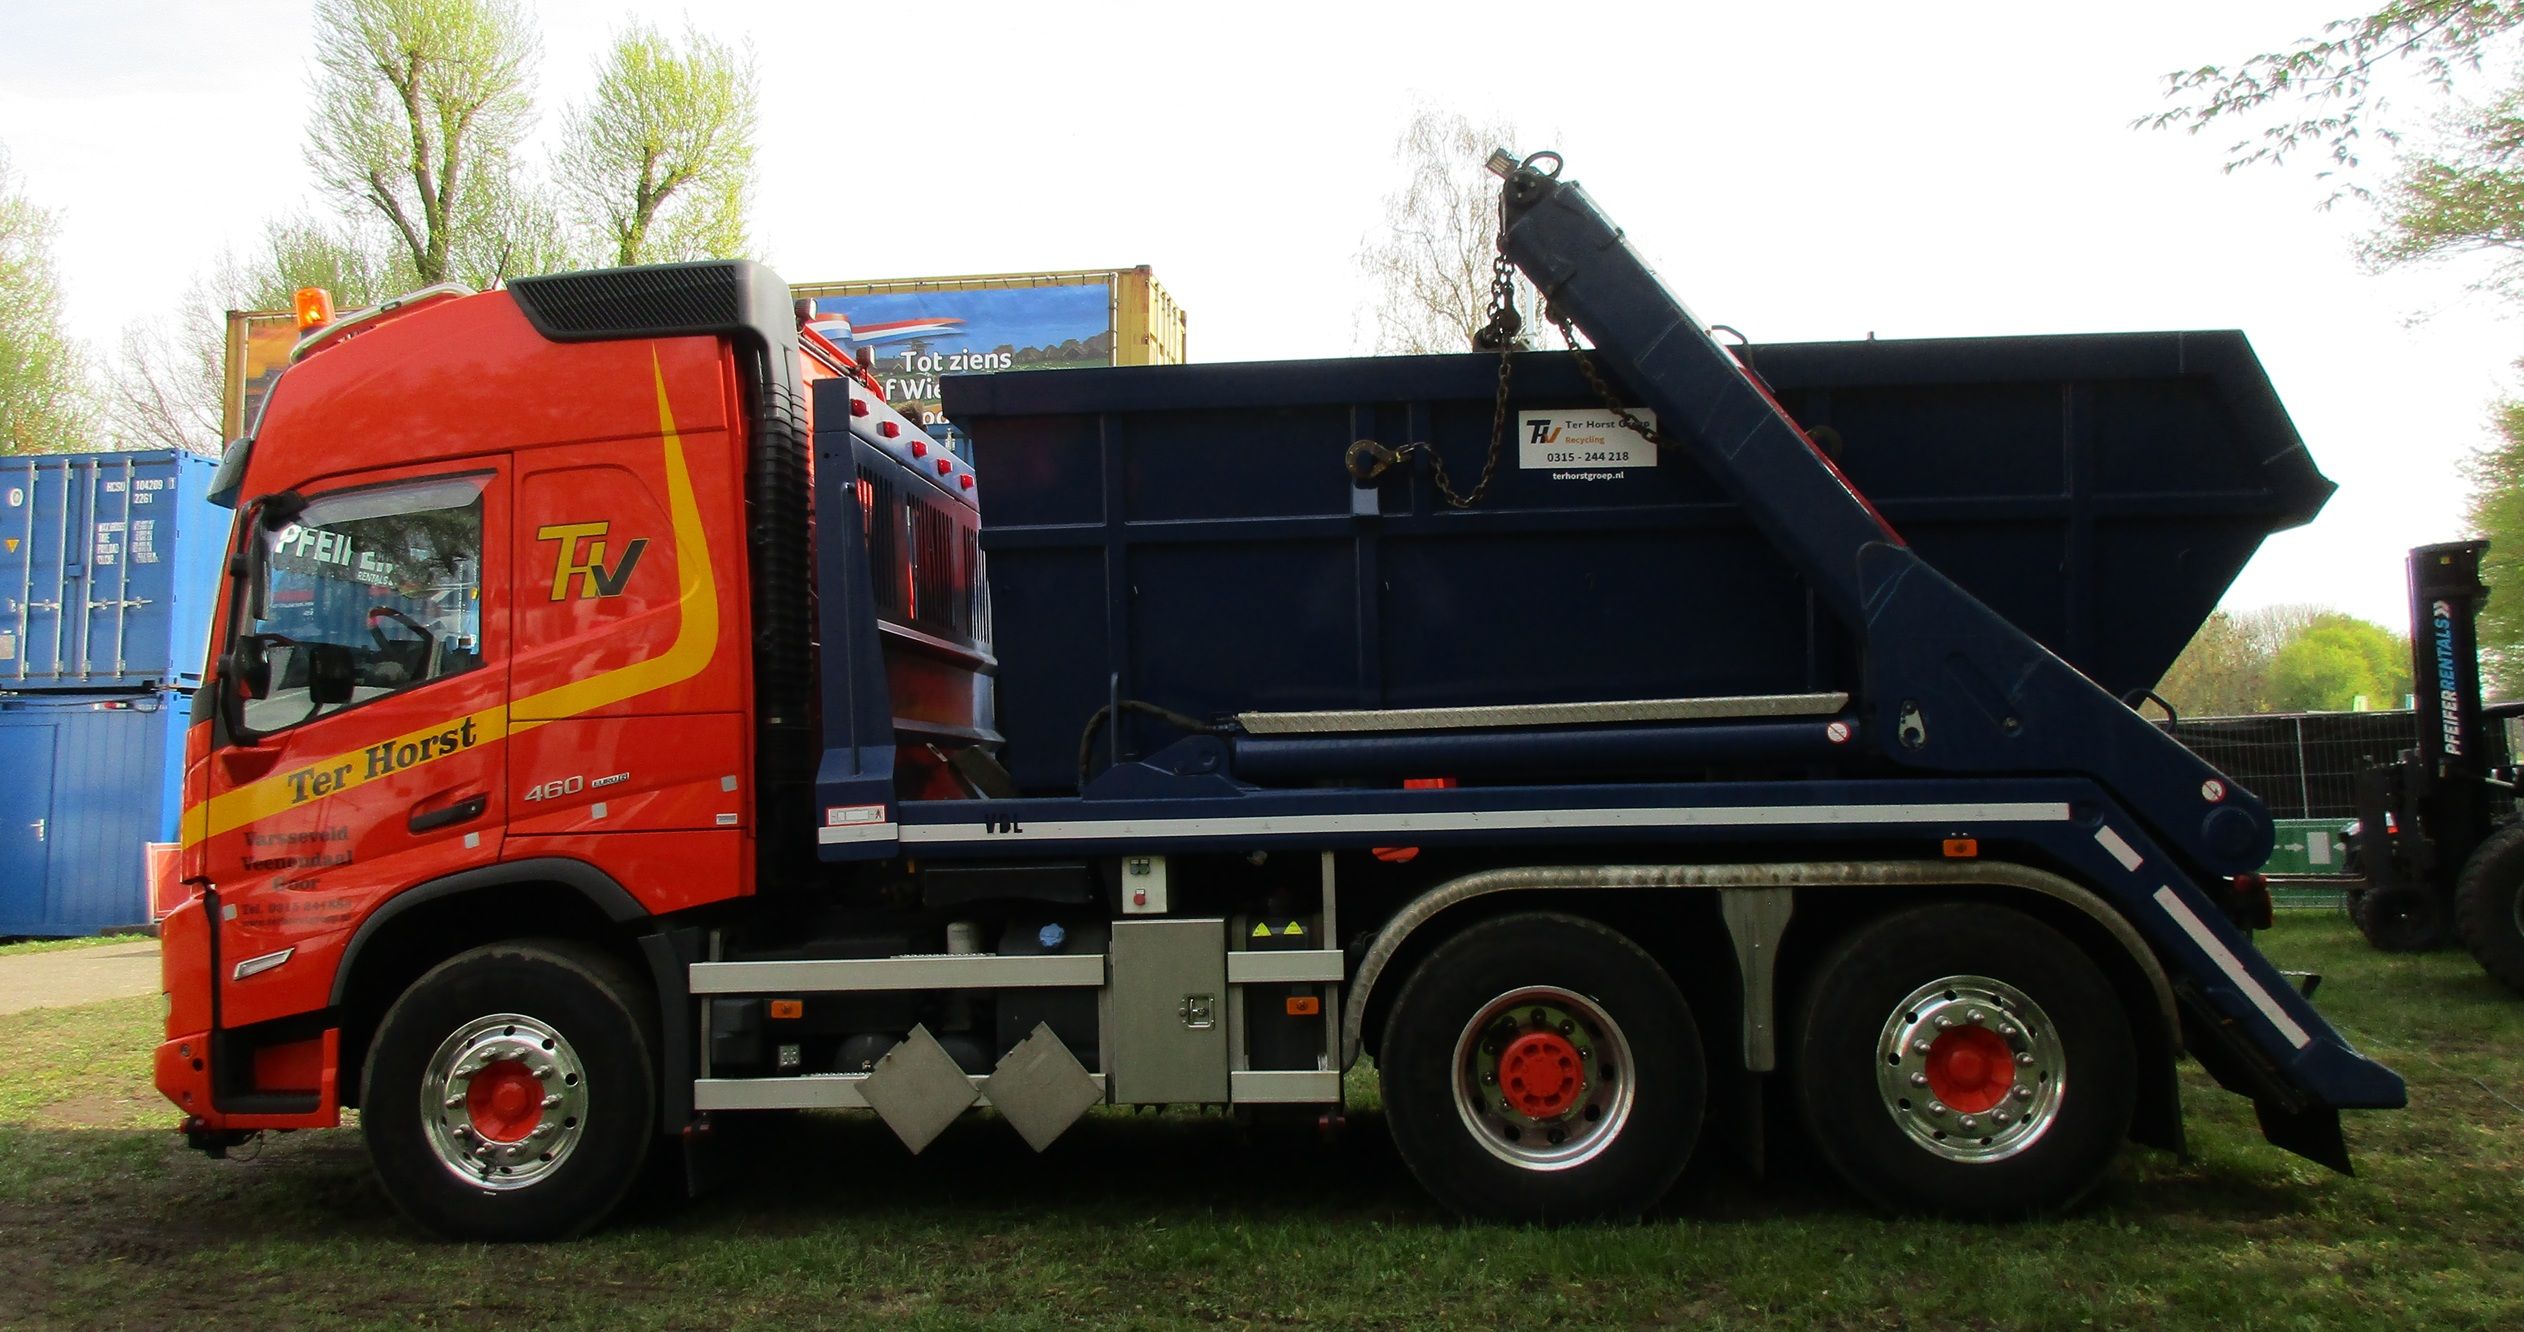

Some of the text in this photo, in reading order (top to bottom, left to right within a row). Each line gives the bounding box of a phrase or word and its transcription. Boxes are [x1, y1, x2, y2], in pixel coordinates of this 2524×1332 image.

[900, 348, 1012, 372] Tot ziens
[885, 377, 942, 400] f Wie
[1565, 420, 1583, 429] Ter
[1586, 419, 1616, 429] Horst
[1565, 436, 1606, 445] Recycling
[1547, 452, 1575, 462] 0315
[1584, 452, 1606, 462] 244
[1608, 451, 1629, 461] 218
[1552, 471, 1625, 482] terhorstgroep.nl
[2433, 618, 2463, 756] PFEIFER RENTALS
[287, 716, 477, 804] Ter Horst
[524, 775, 584, 802] 460
[241, 850, 353, 871] Veenendaal
